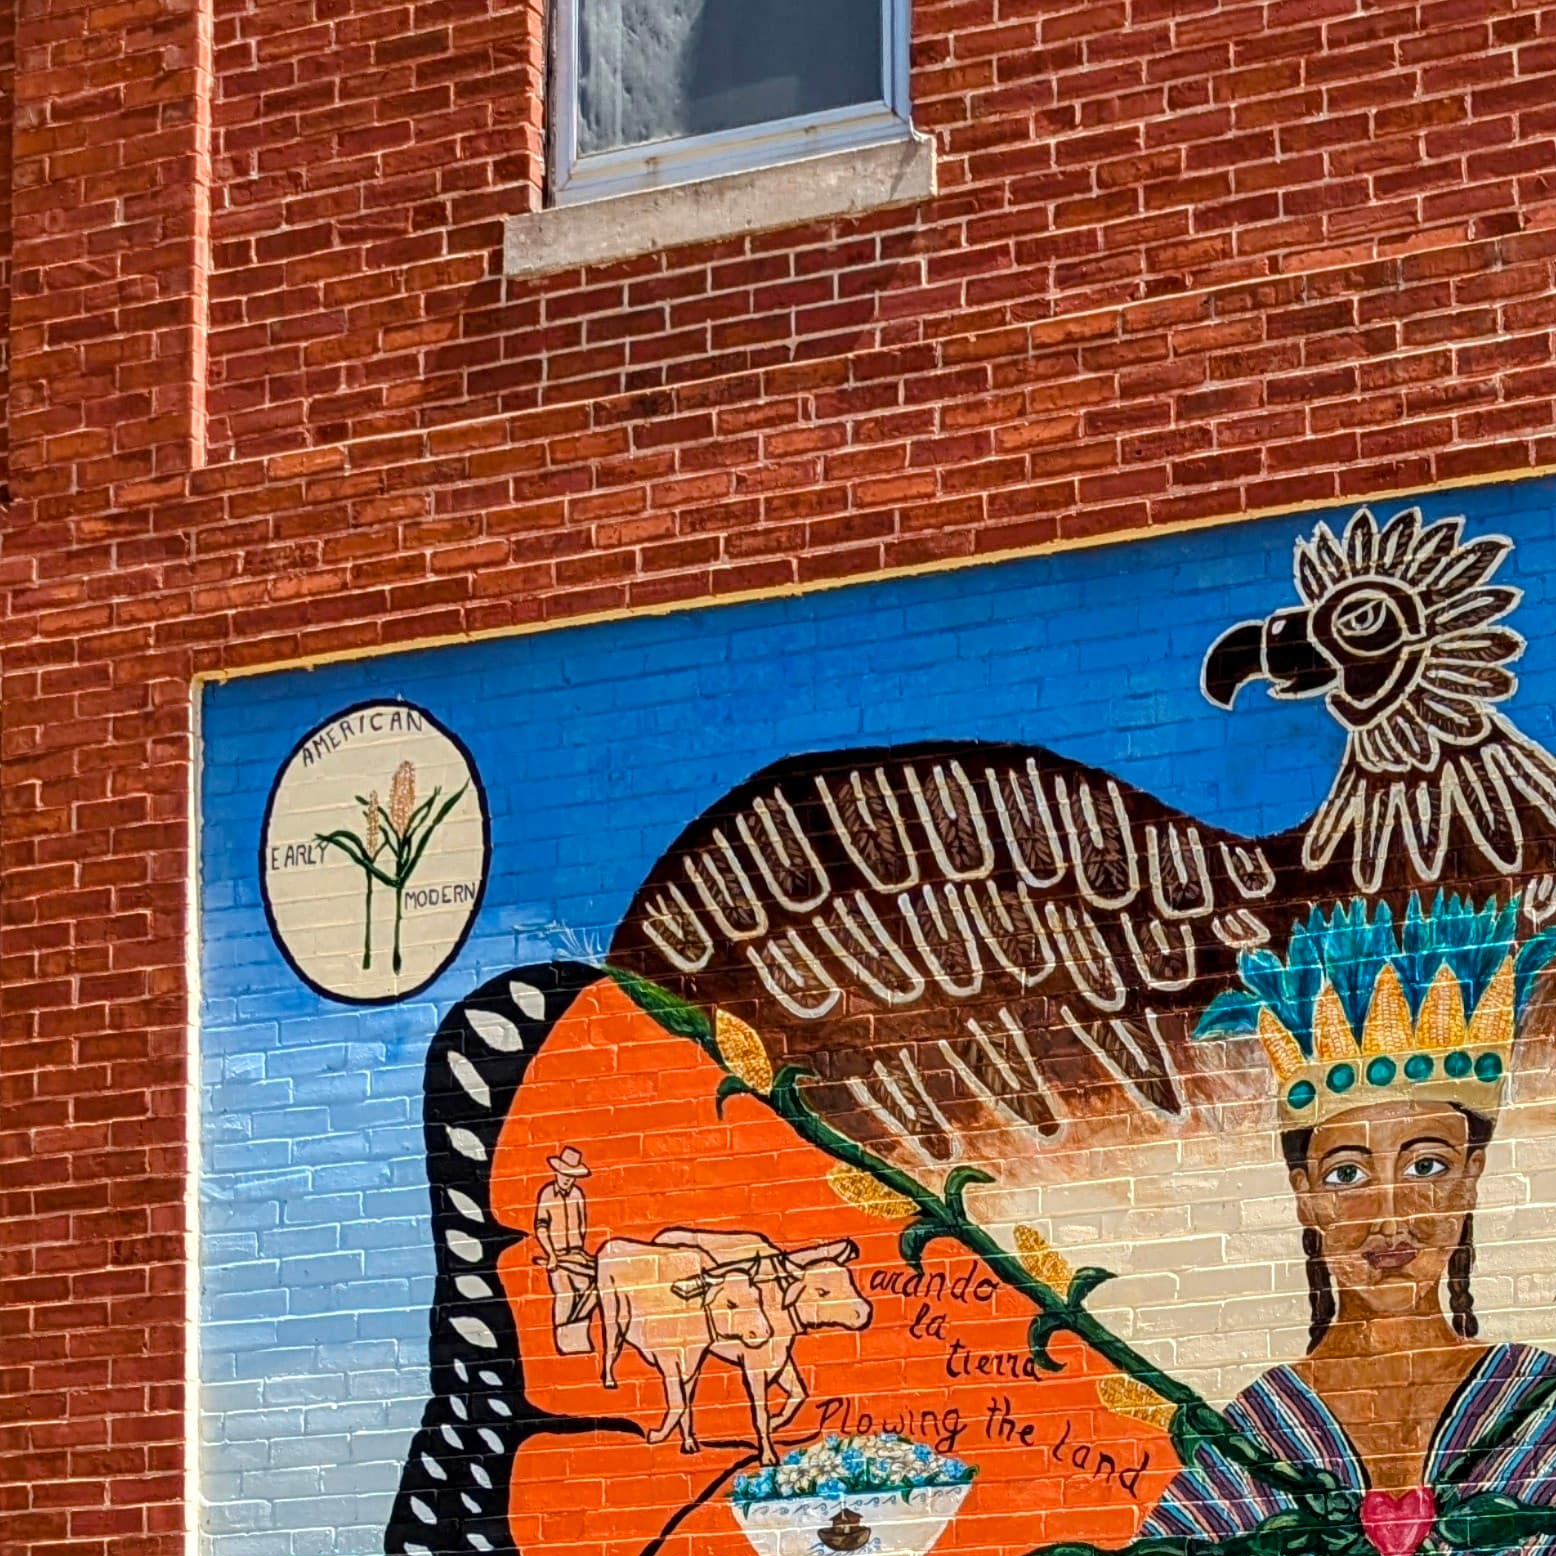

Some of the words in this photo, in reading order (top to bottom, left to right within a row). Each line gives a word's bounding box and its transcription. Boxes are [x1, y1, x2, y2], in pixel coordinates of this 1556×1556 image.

[301, 709, 423, 768] AMERICAN
[271, 842, 330, 871] EARLY
[404, 882, 477, 910] MODERN
[870, 1260, 999, 1303] arando
[909, 1303, 946, 1340] la
[947, 1339, 1043, 1382] tierra
[816, 1398, 968, 1454] Plowing
[986, 1396, 1035, 1447] the
